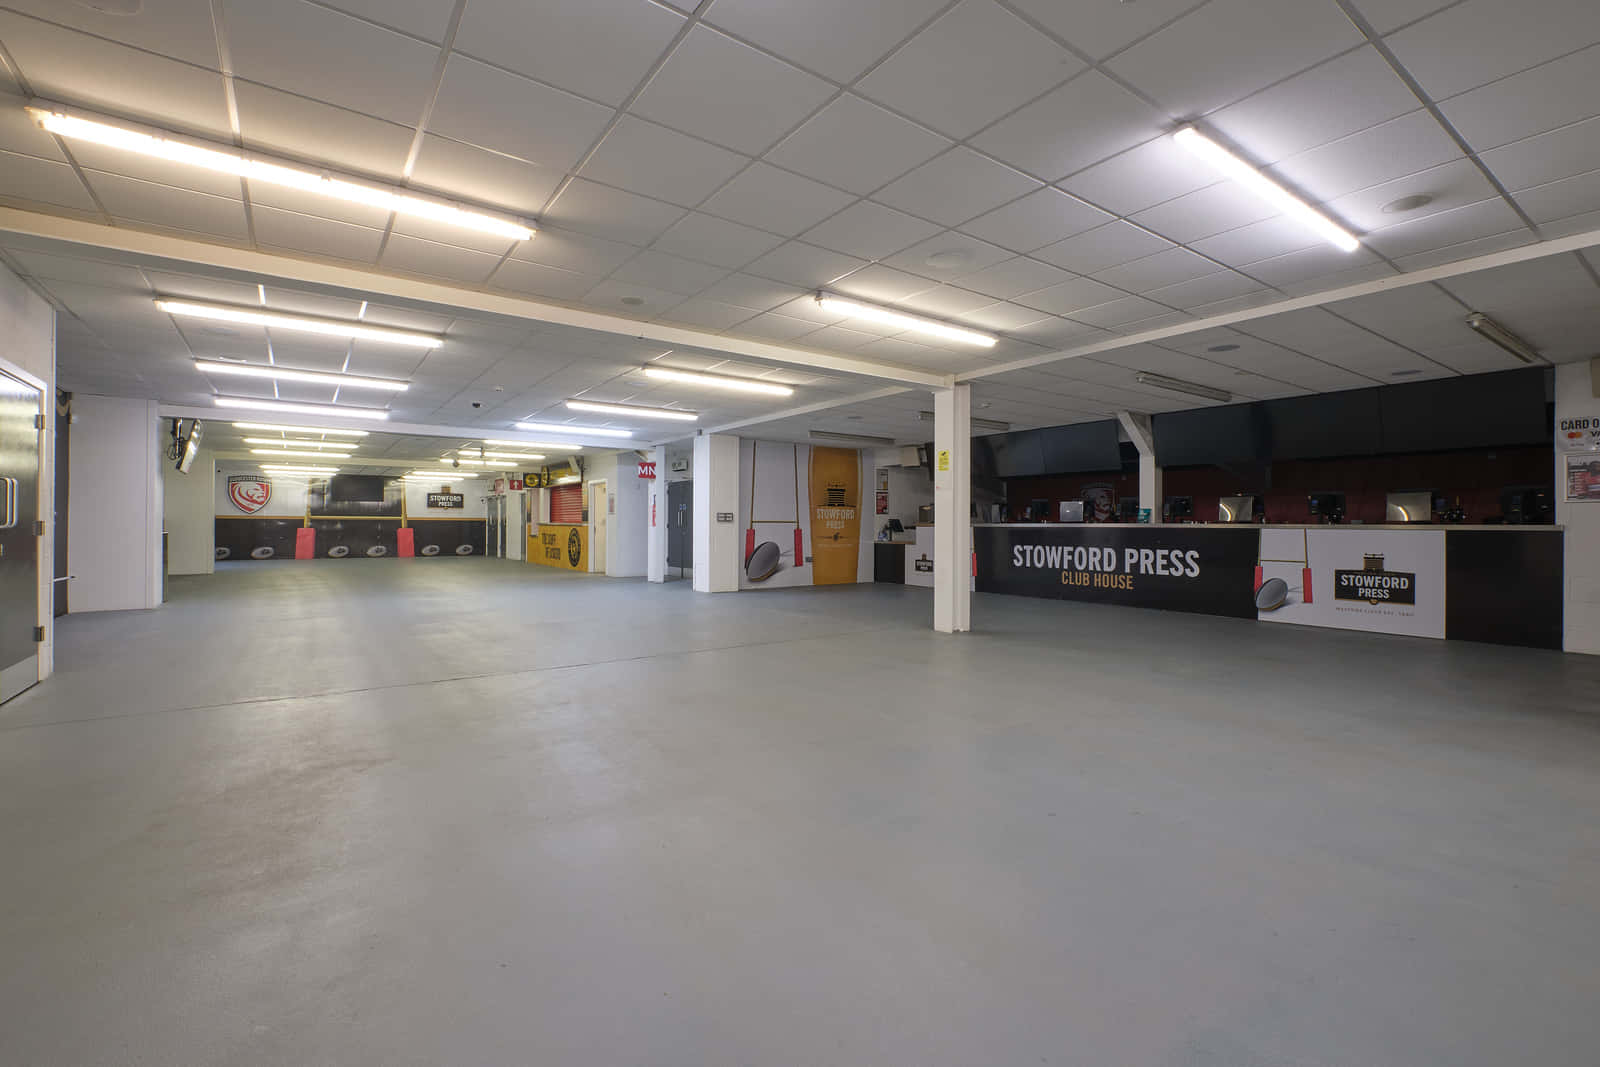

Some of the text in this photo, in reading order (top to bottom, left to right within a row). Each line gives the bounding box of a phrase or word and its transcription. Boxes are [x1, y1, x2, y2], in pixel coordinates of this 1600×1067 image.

[1561, 419, 1589, 431] CARD
[816, 508, 856, 520] STOWFORD
[1013, 544, 1200, 578] STOWFORD PRESS
[1061, 571, 1135, 590] CLUB HOUSE
[1340, 574, 1409, 590] STOWFORD
[1358, 587, 1390, 599] PRESS
